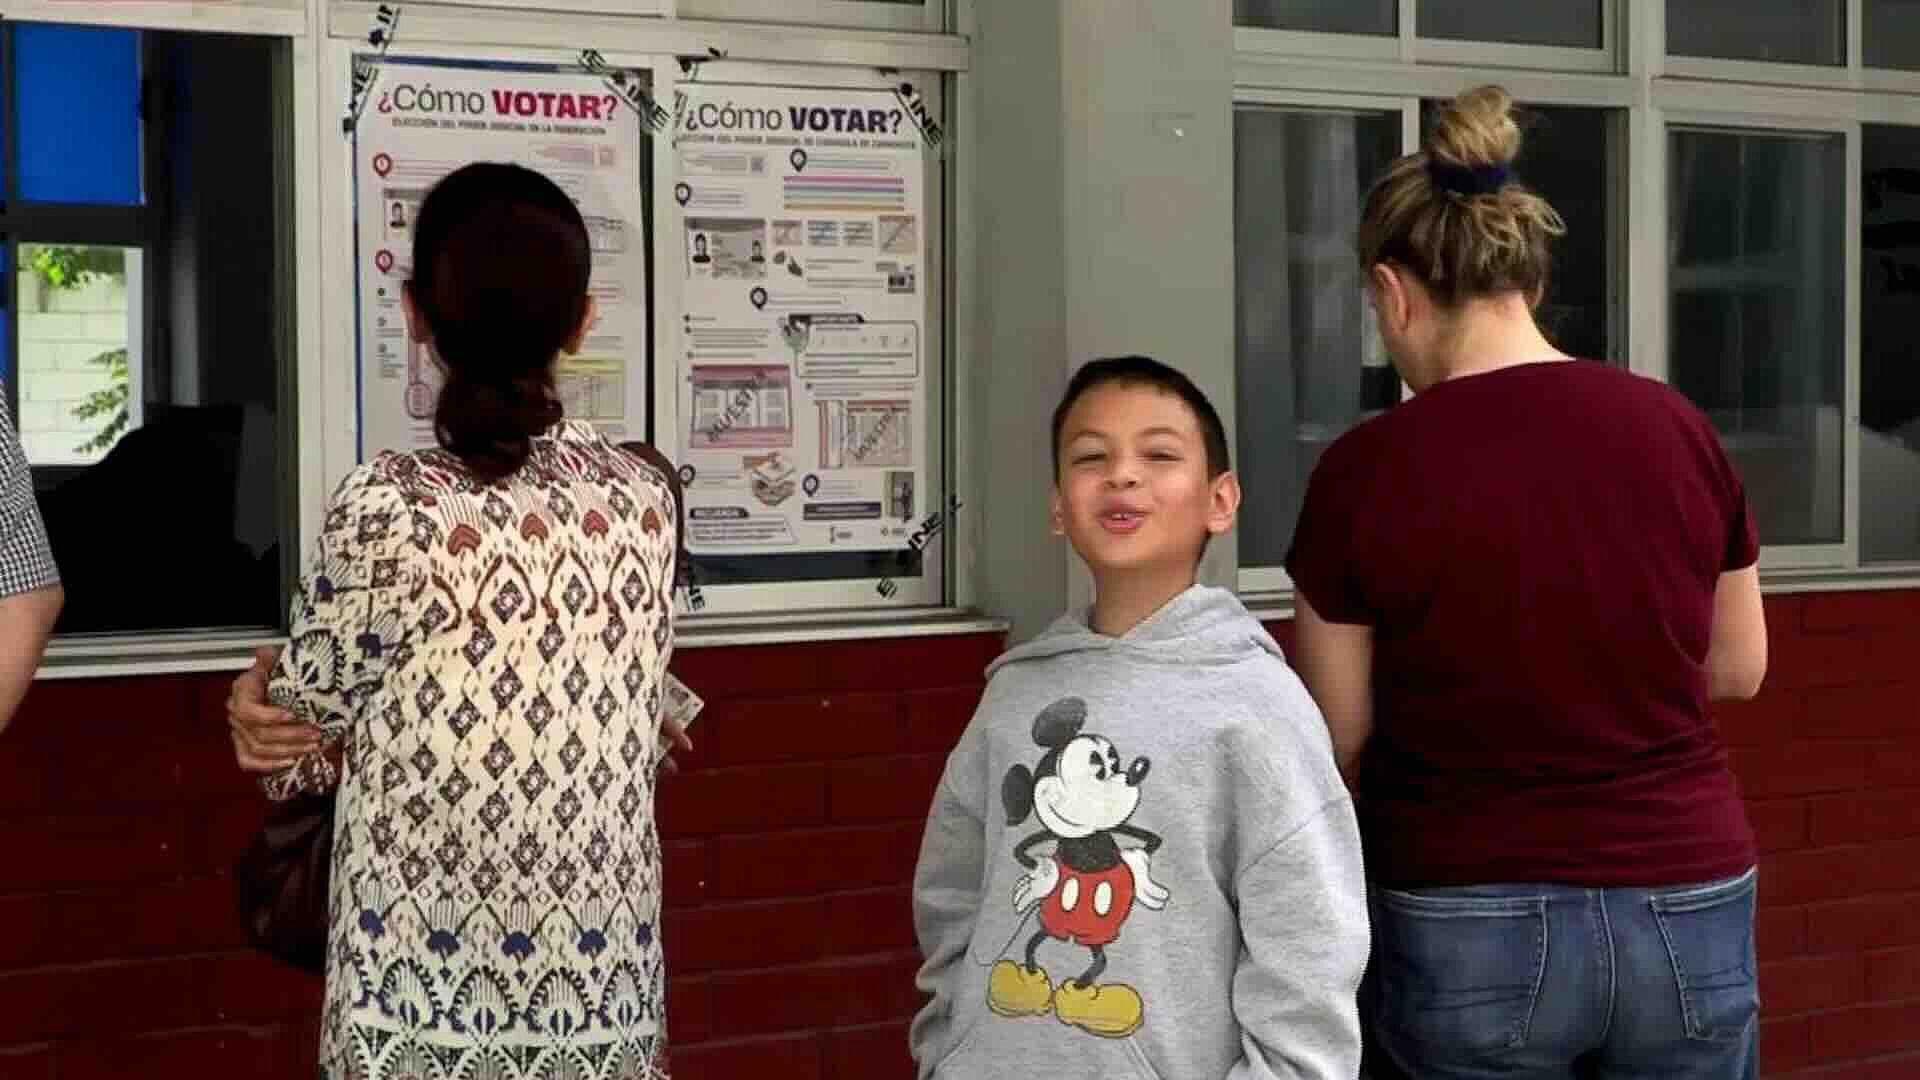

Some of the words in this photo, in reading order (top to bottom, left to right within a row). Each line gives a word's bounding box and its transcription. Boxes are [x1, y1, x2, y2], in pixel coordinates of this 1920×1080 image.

[378, 82, 485, 115] ¿Cómo
[492, 89, 618, 121] VOTAR?
[686, 101, 782, 131] ¿Cómo
[788, 106, 902, 134] VOTAR?
[908, 512, 940, 550] INE
